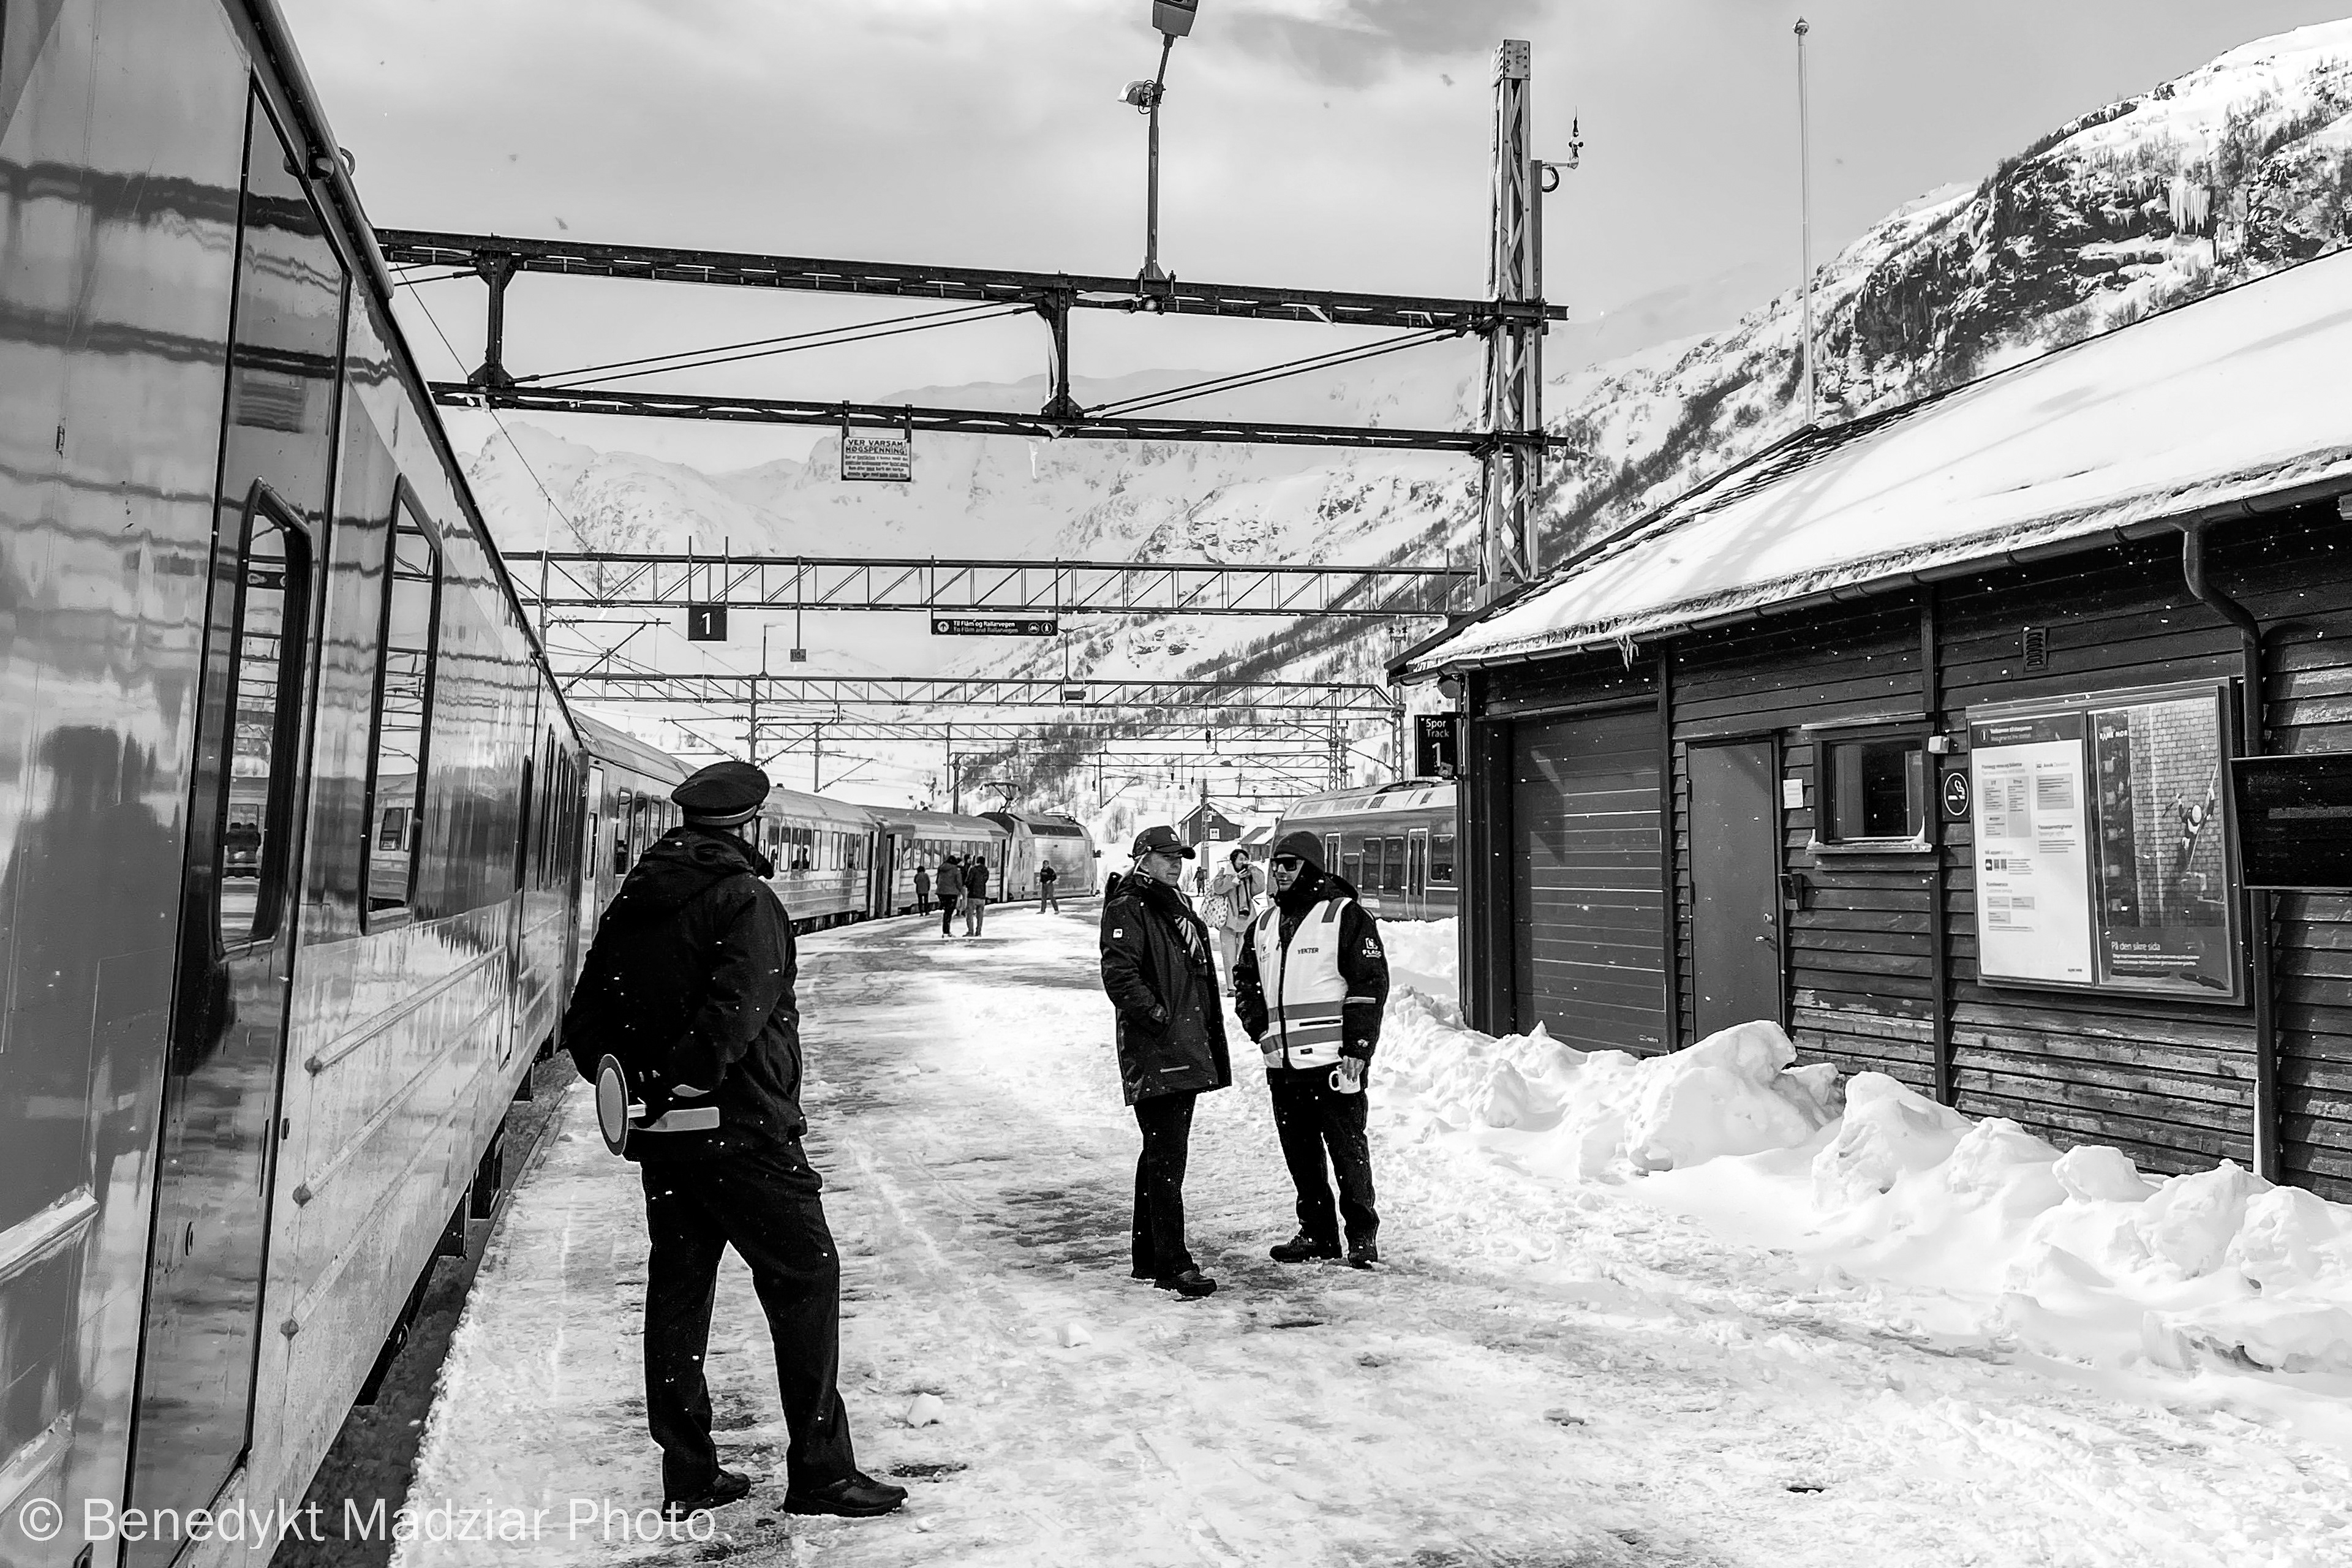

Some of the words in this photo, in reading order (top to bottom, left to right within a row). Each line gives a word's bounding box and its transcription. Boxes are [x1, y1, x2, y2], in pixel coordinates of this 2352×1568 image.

[702, 612, 710, 635] 1
[1426, 718, 1446, 729] Spor
[1426, 729, 1449, 737] Track
[1432, 742, 1441, 767] 1
